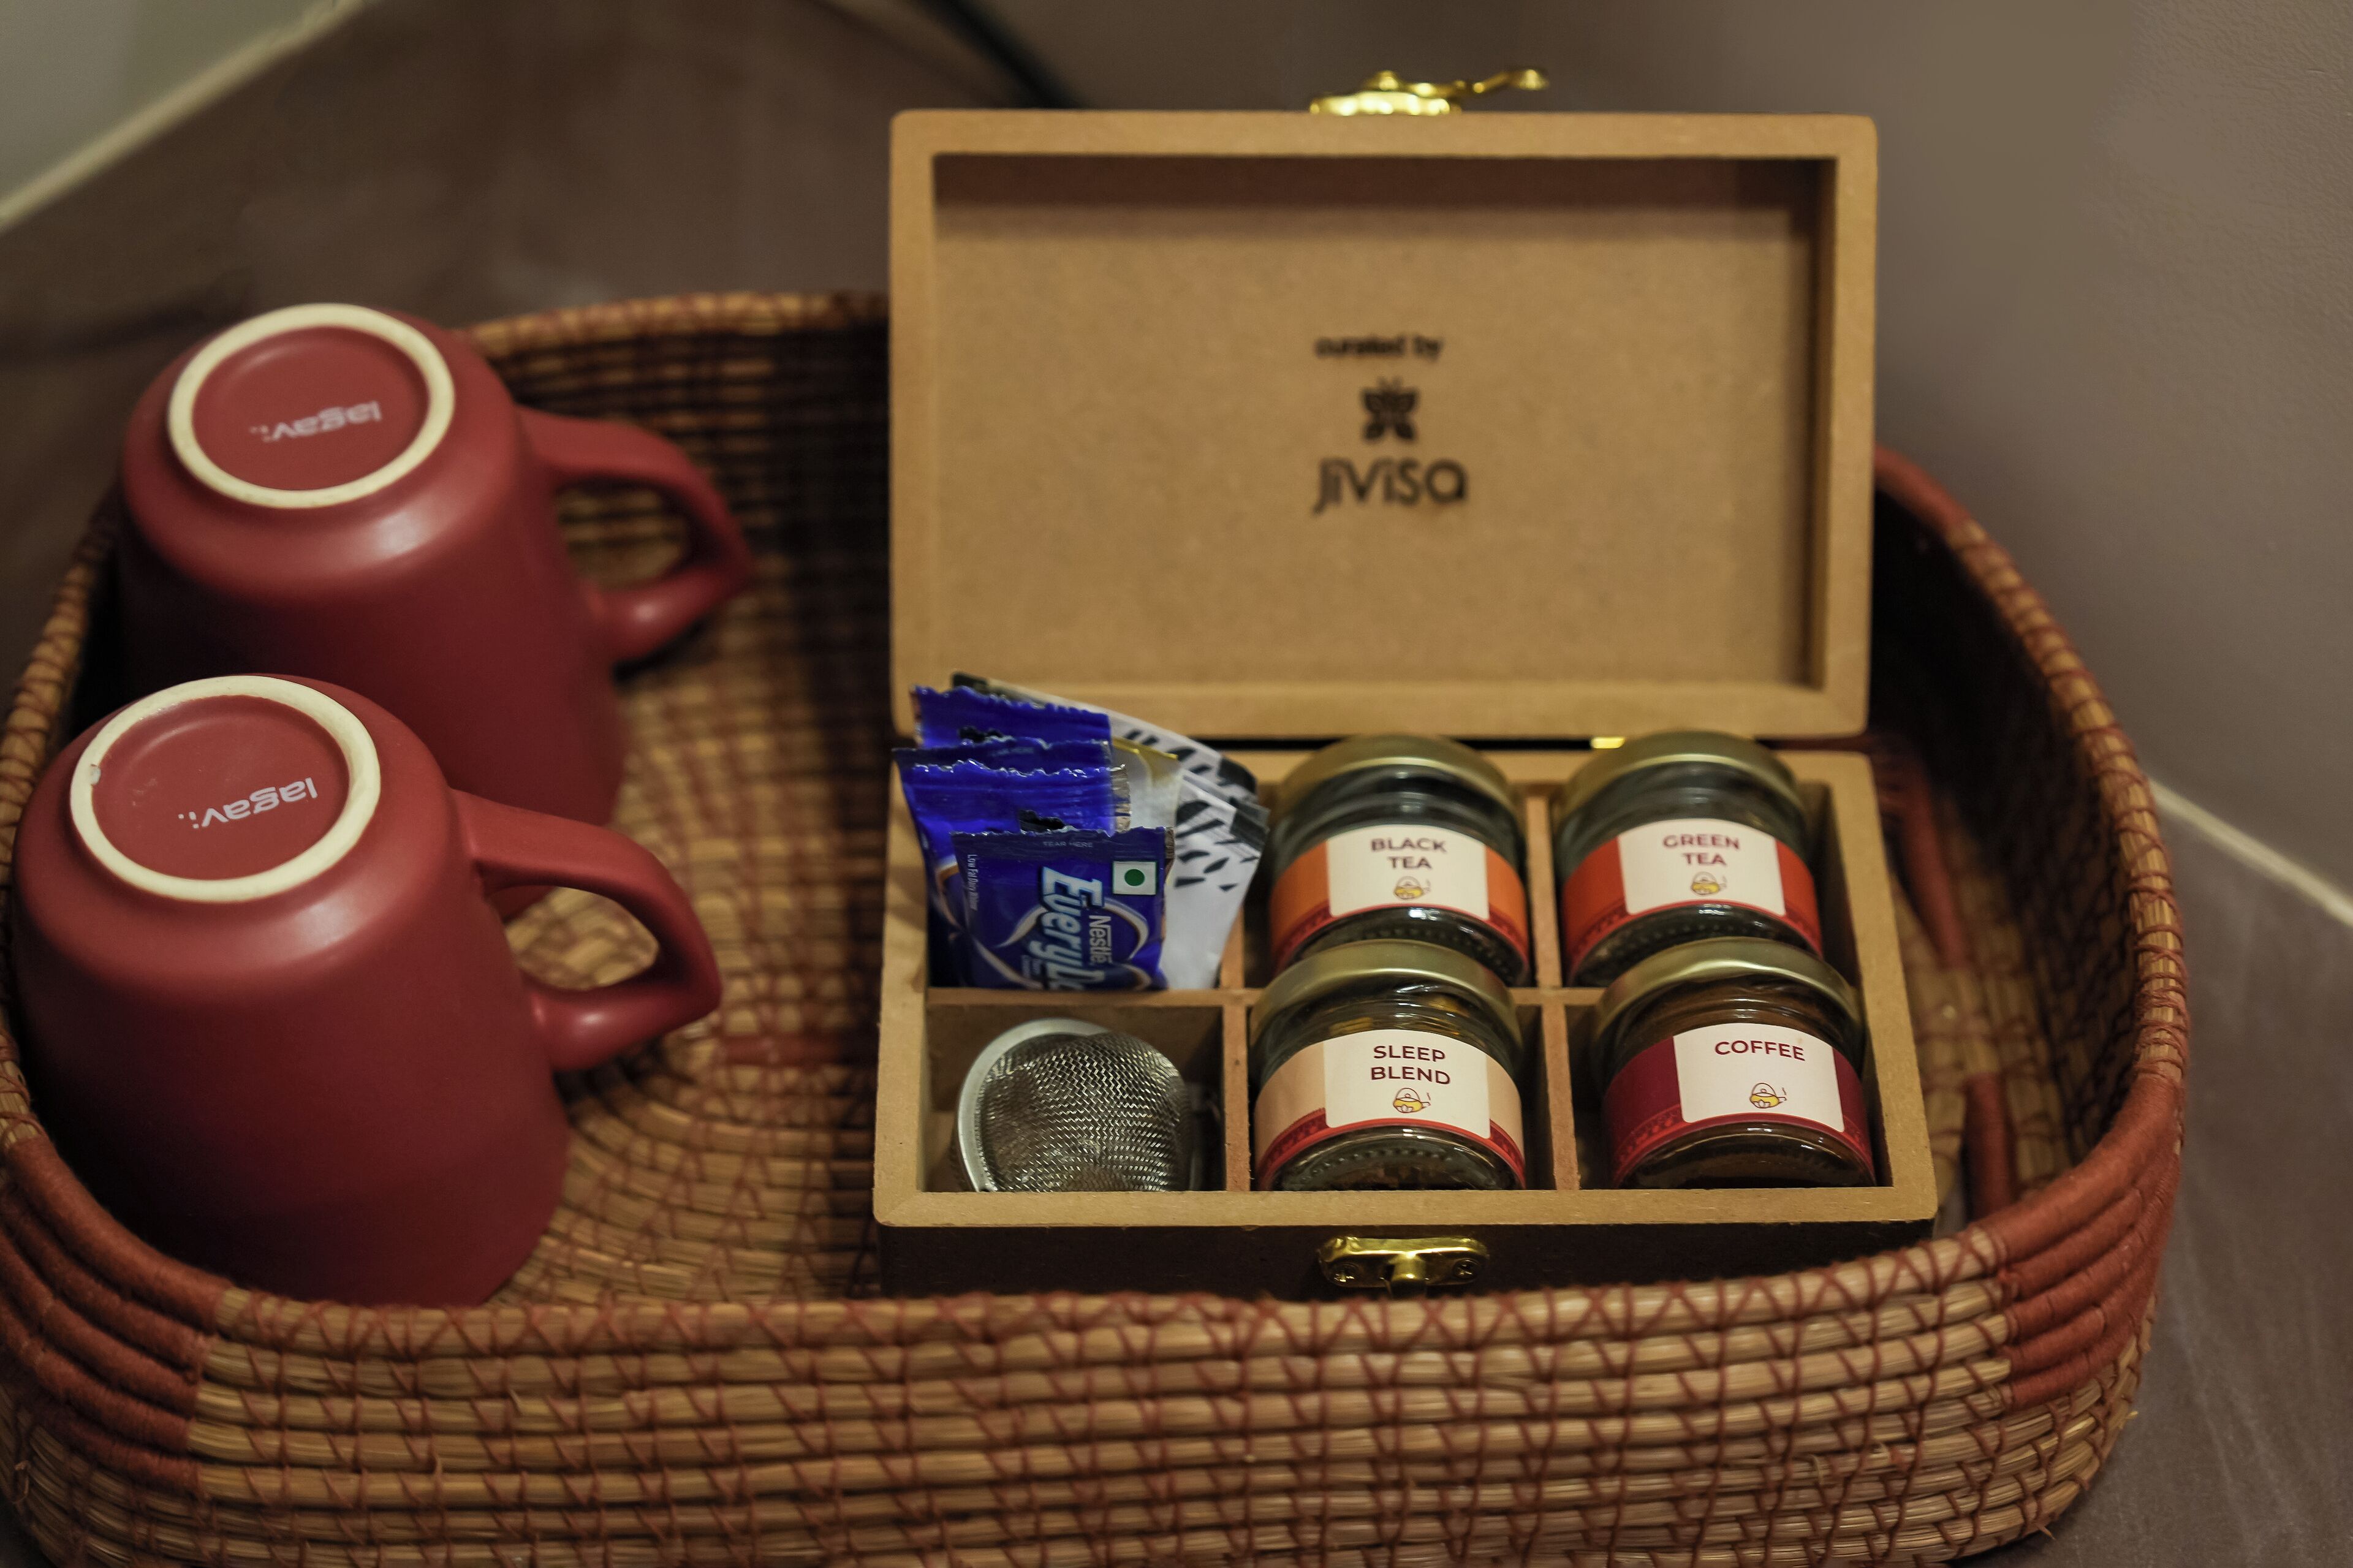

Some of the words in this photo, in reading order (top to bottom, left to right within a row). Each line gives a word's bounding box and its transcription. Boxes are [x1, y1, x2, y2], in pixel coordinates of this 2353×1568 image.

[1371, 837, 1447, 853] BLACK
[1662, 834, 1739, 850] GREEN
[968, 854, 978, 868] Low
[1388, 856, 1431, 869] TEA
[1683, 852, 1727, 866] TEA
[1373, 1045, 1446, 1062] SLEEP
[1715, 1040, 1806, 1061] COFFEE
[1371, 1066, 1450, 1085] BLEND
